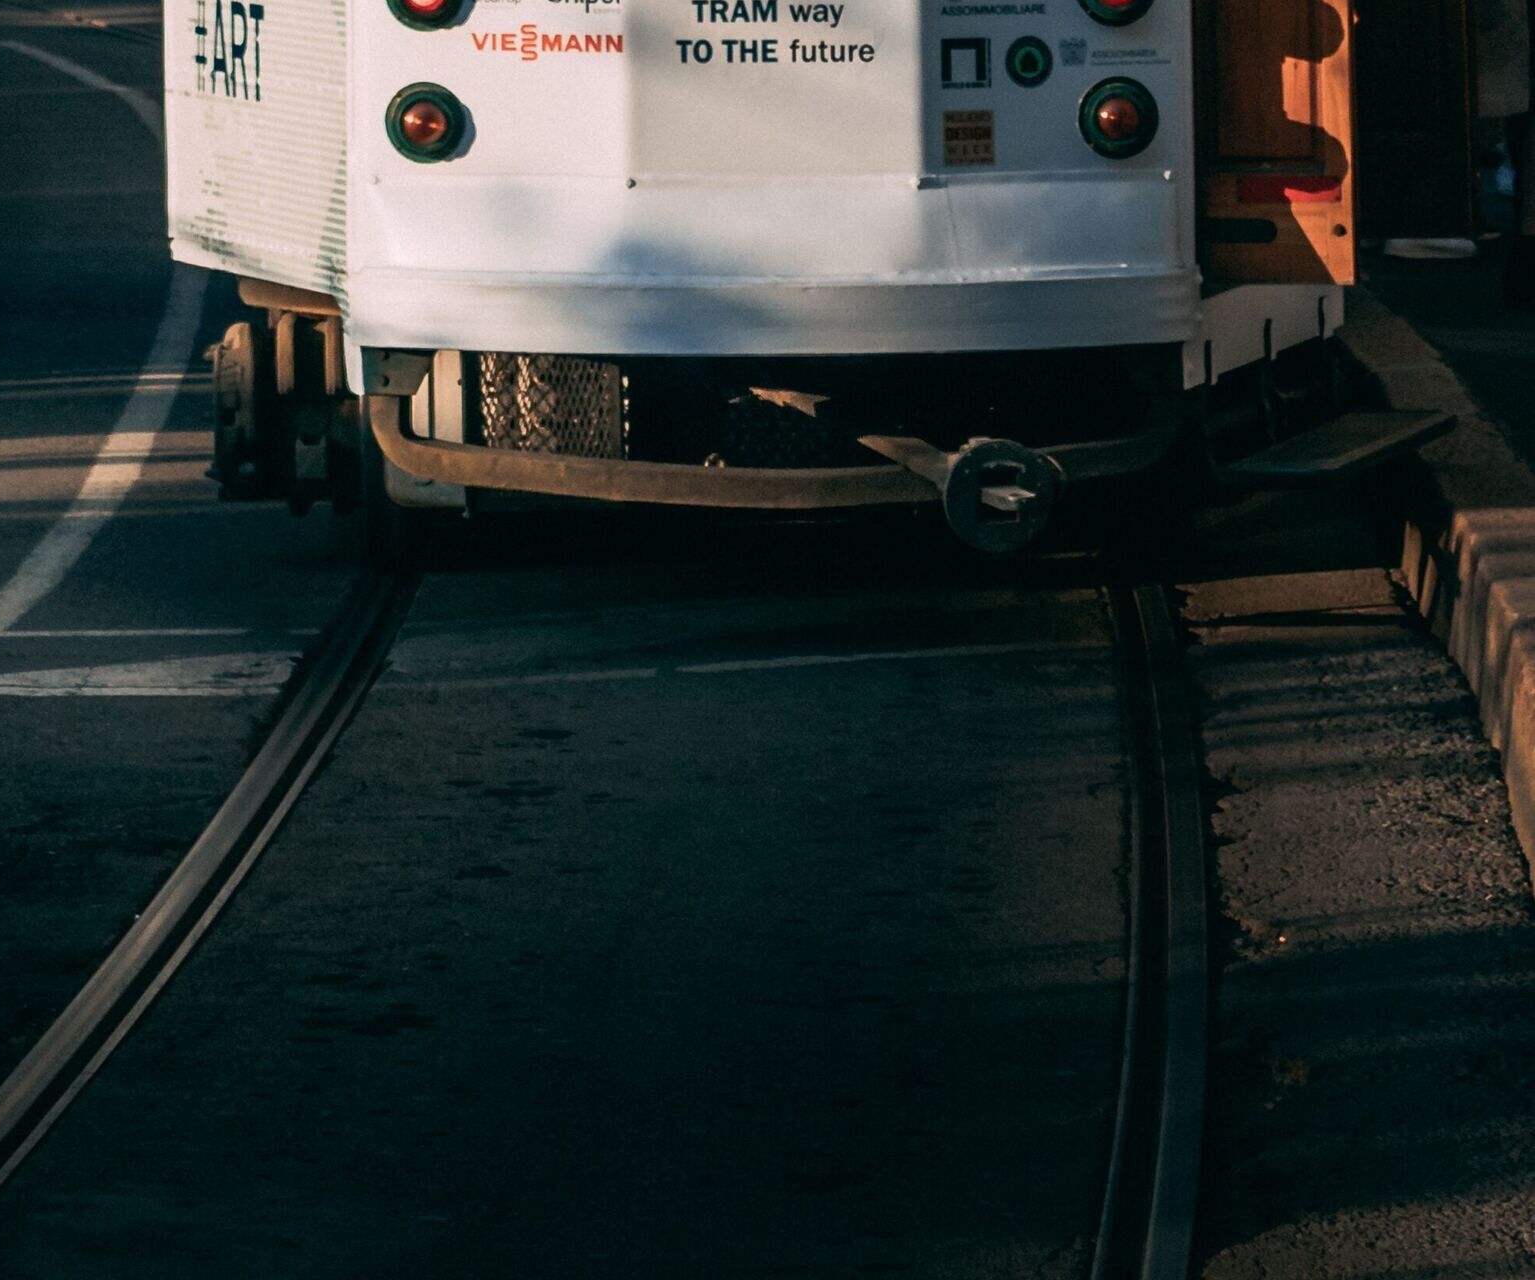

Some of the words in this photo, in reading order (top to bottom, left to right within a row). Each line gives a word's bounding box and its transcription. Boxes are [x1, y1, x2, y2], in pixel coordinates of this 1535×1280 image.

[692, 0, 778, 23] TRAM
[789, 3, 844, 28] way
[472, 24, 624, 61] VIESSMANN
[676, 39, 713, 64] TO
[722, 39, 778, 64] THE
[789, 39, 875, 63] future
